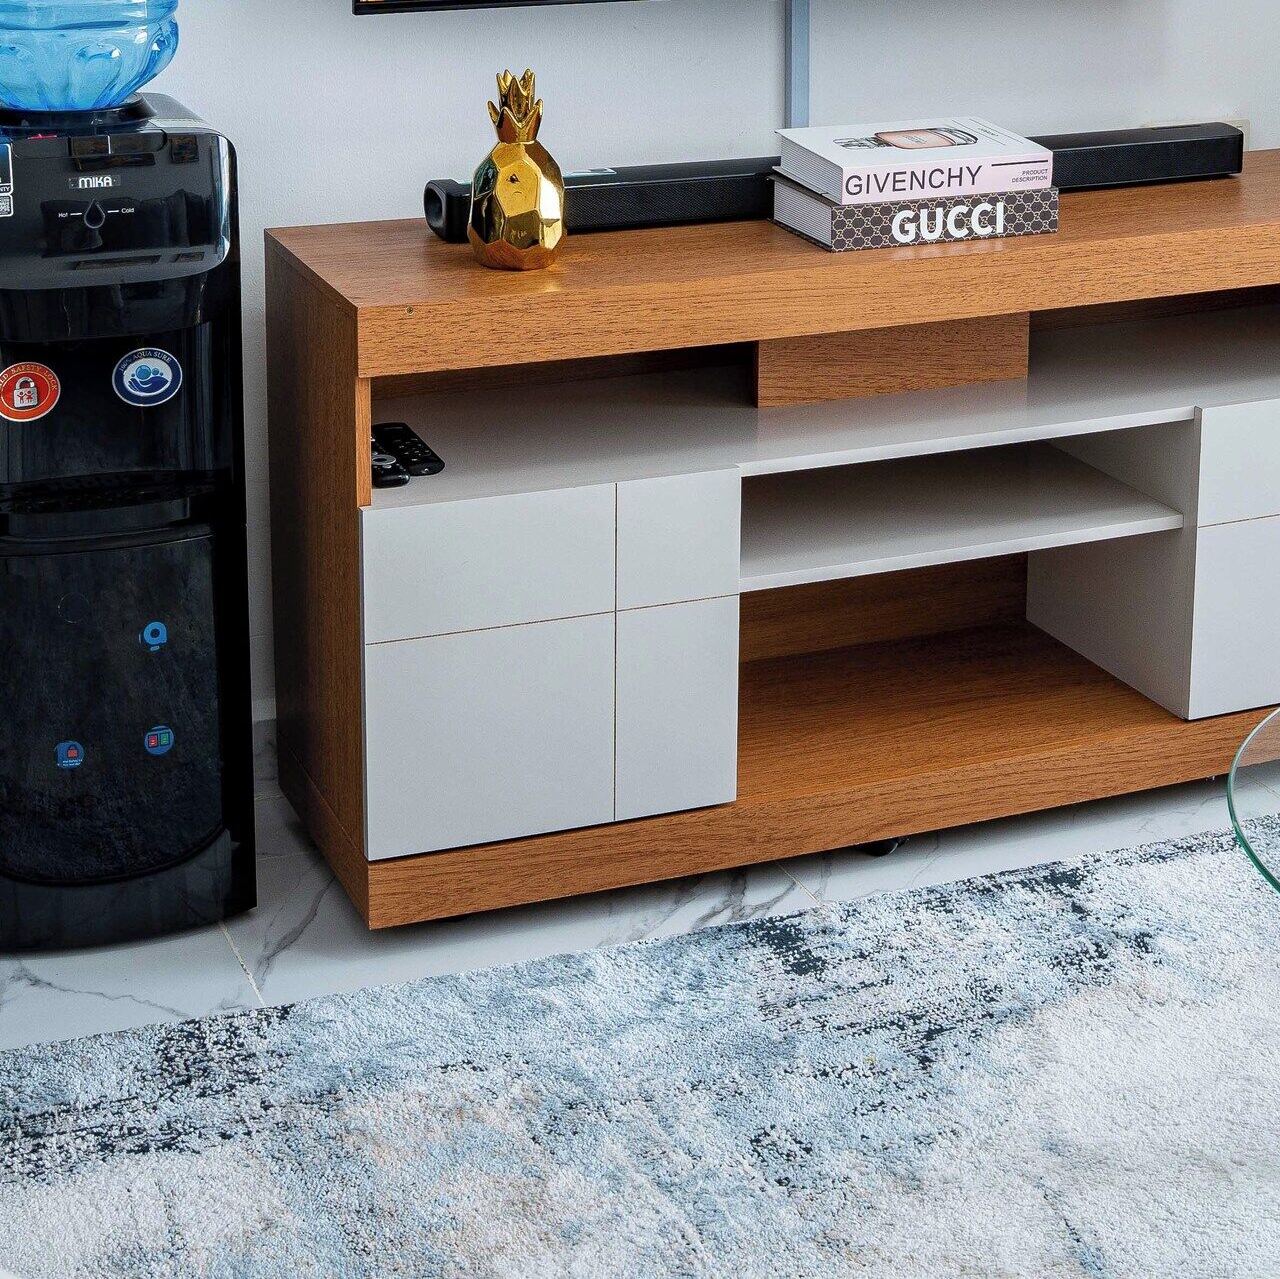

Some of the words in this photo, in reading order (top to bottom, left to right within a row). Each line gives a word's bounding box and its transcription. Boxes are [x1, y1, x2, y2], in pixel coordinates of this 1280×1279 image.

[845, 165, 983, 196] GIVENCHY
[1011, 175, 1048, 183] DESCRIPTION
[892, 201, 1005, 244] GUCCI
[133, 351, 152, 359] AQUA
[153, 351, 172, 363] SURE
[11, 364, 42, 374] SAFETY
[43, 370, 58, 390] LOCK
